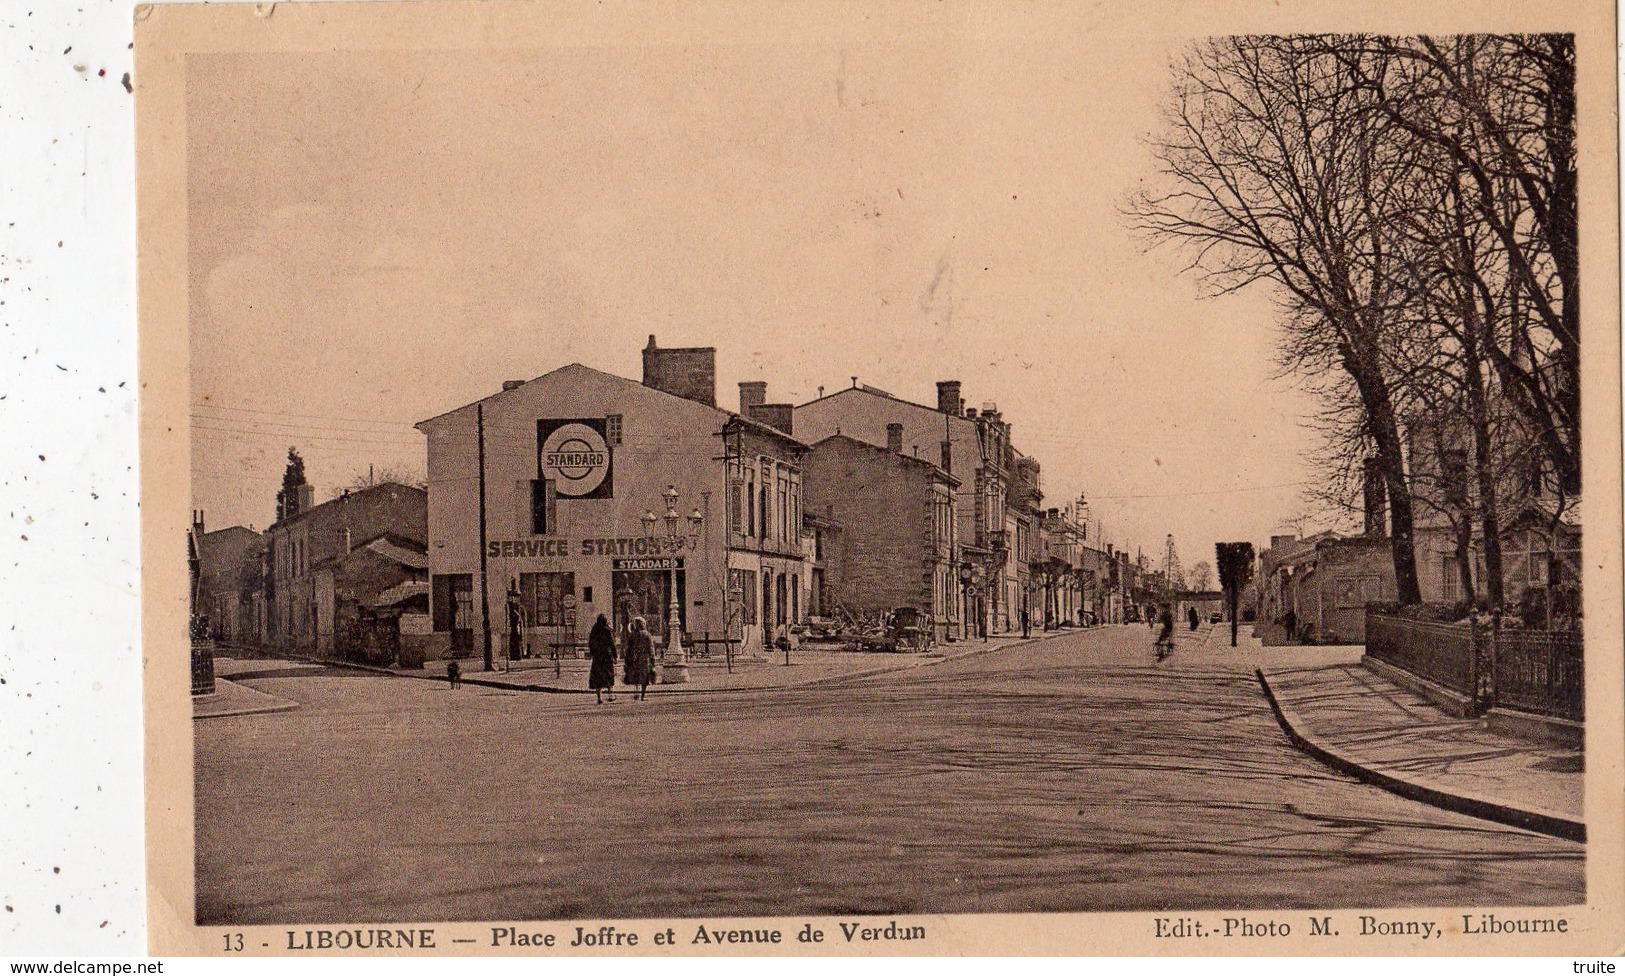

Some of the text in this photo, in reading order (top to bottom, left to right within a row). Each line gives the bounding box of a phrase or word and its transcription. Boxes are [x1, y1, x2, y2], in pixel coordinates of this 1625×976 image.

[547, 453, 604, 466] STANDARD
[487, 537, 661, 558] SERVICE STATION
[619, 559, 679, 569] STANDARD
